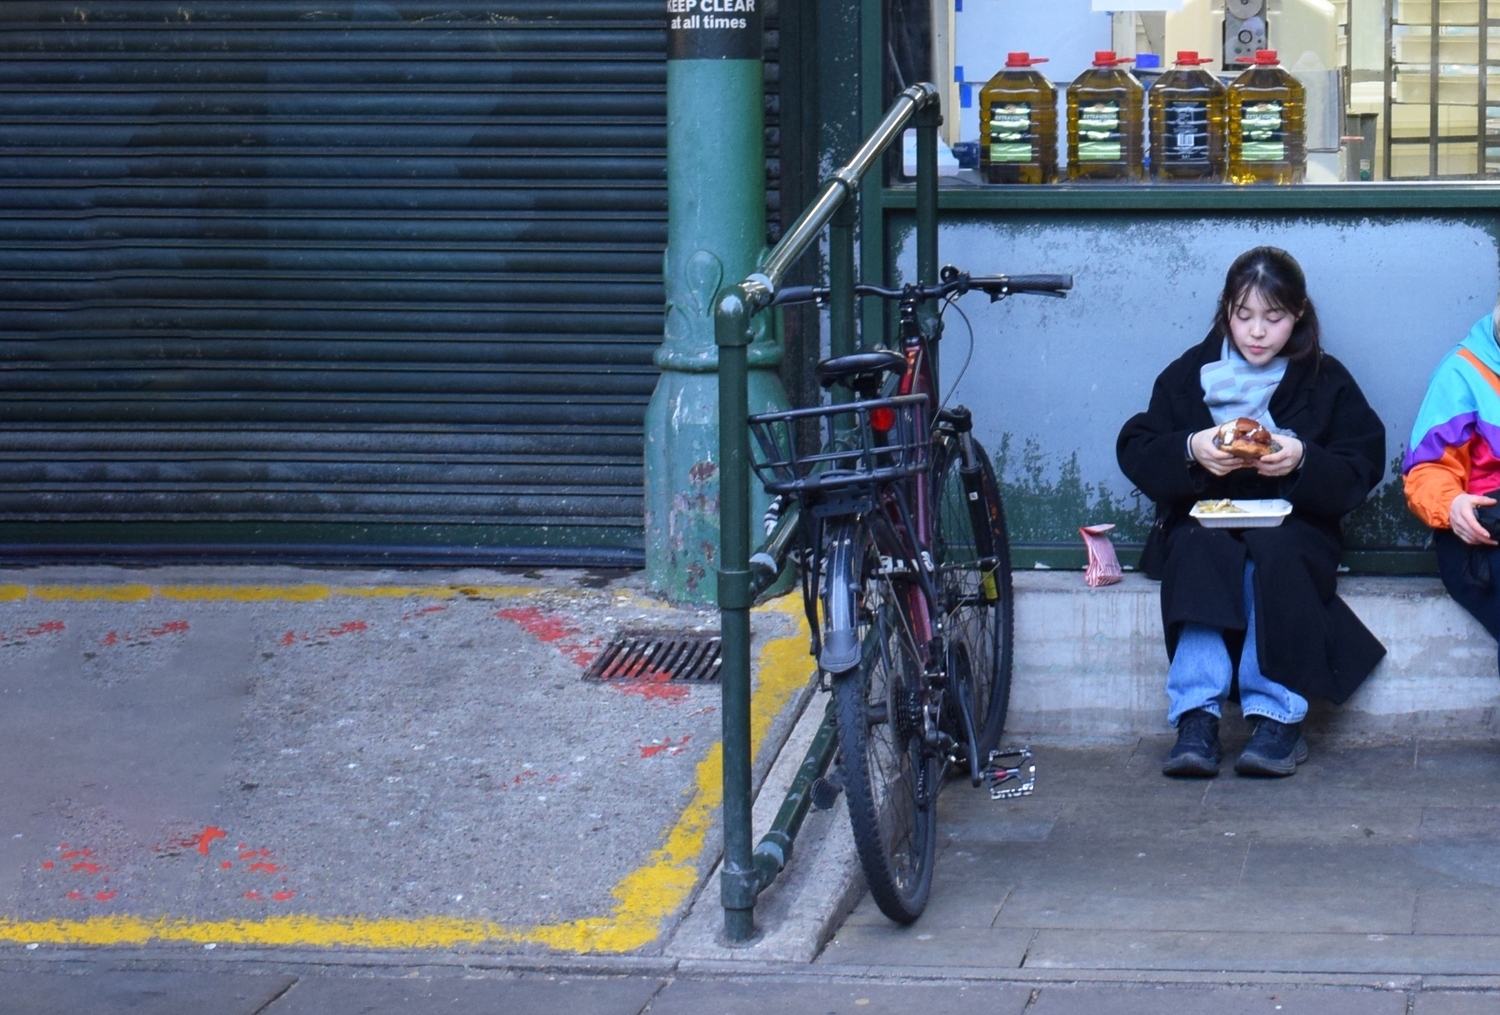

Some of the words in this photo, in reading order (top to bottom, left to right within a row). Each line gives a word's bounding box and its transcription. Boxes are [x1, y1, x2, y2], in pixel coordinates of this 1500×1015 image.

[671, 15, 681, 29] at
[683, 15, 700, 29] all
[703, 15, 747, 29] times
